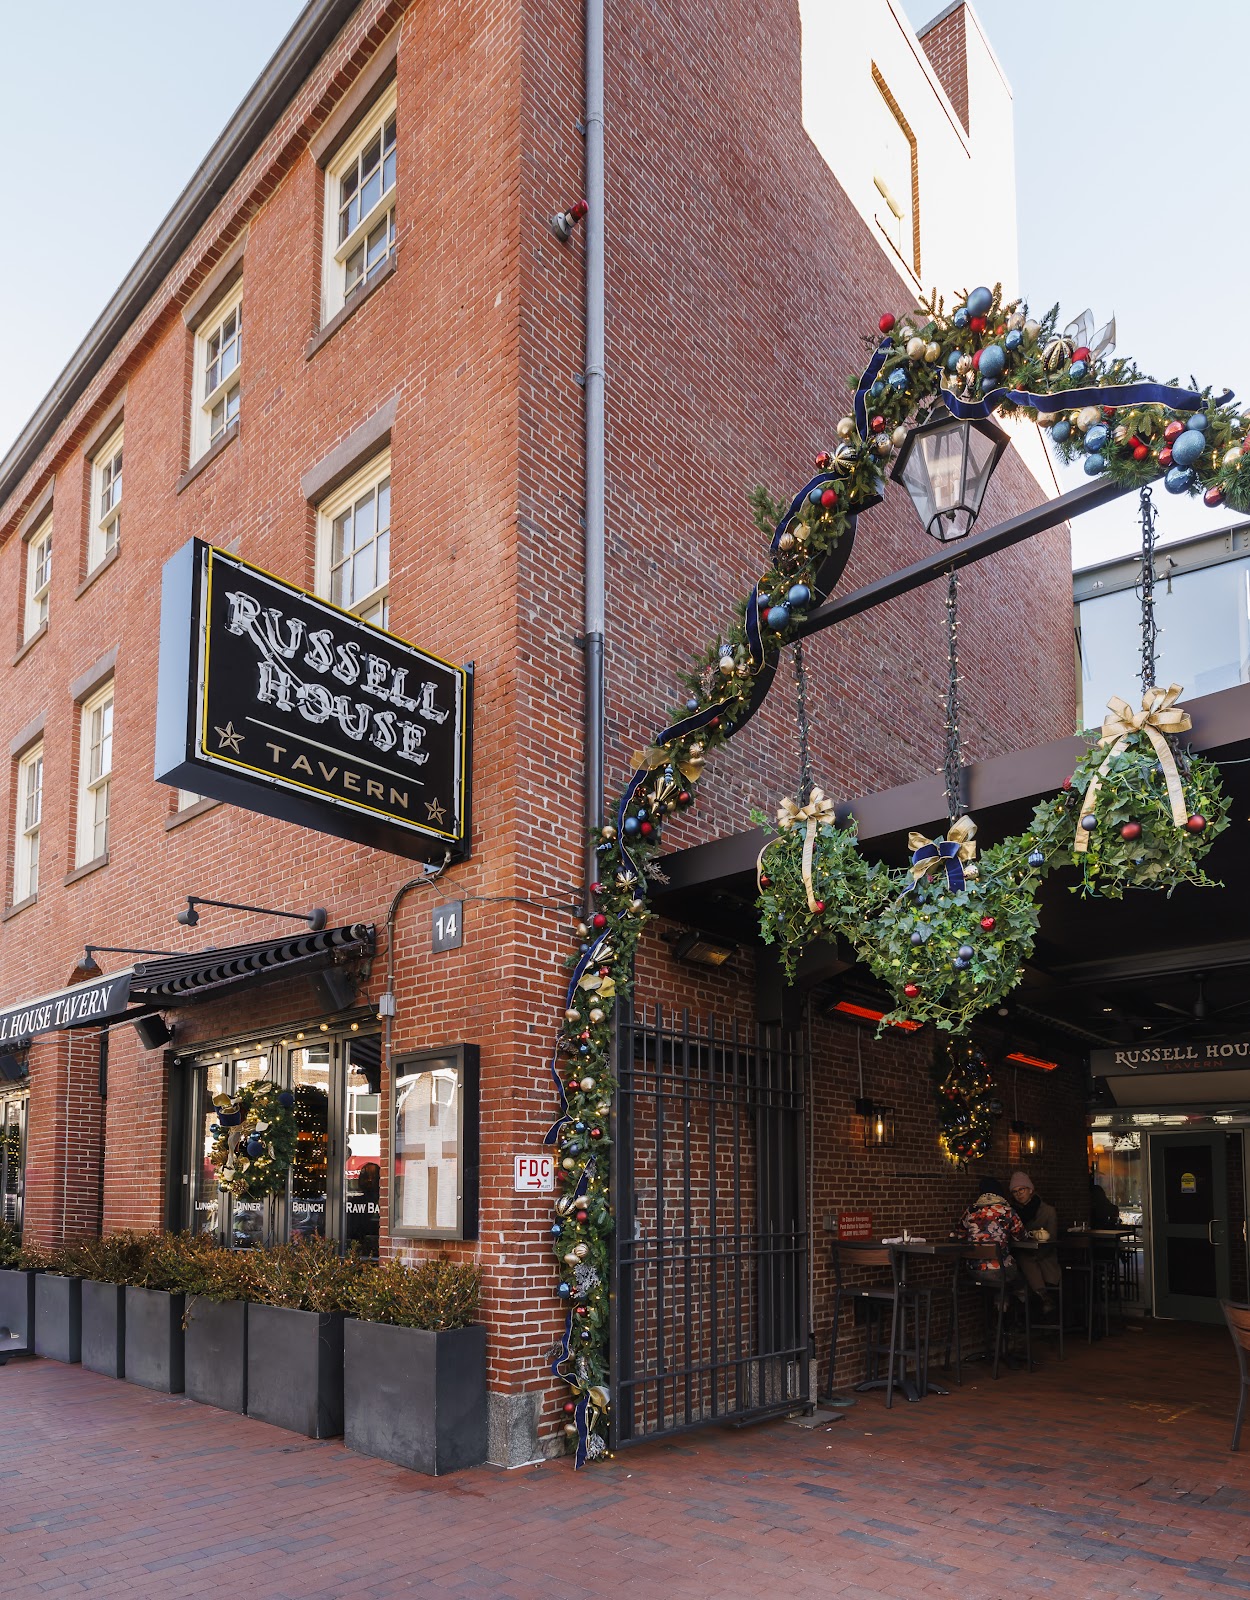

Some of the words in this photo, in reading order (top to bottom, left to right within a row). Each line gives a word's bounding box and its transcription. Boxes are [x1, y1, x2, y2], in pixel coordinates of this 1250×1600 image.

[224, 591, 449, 724] RUSSELL
[257, 661, 430, 766] HOUSE
[266, 742, 409, 809] TAVERN
[435, 913, 457, 941] 14
[9, 1004, 53, 1038] HOUSE
[54, 985, 113, 1026] TAVERN
[1115, 1046, 1198, 1069] RUSSELL
[1206, 1043, 1250, 1058] HOU
[1164, 1060, 1224, 1070] TAVERN
[519, 1159, 550, 1177] FDC
[236, 1201, 261, 1211] DINNER
[292, 1202, 323, 1213] BRUNCH
[345, 1202, 366, 1213] RAW
[367, 1202, 380, 1213] BA
